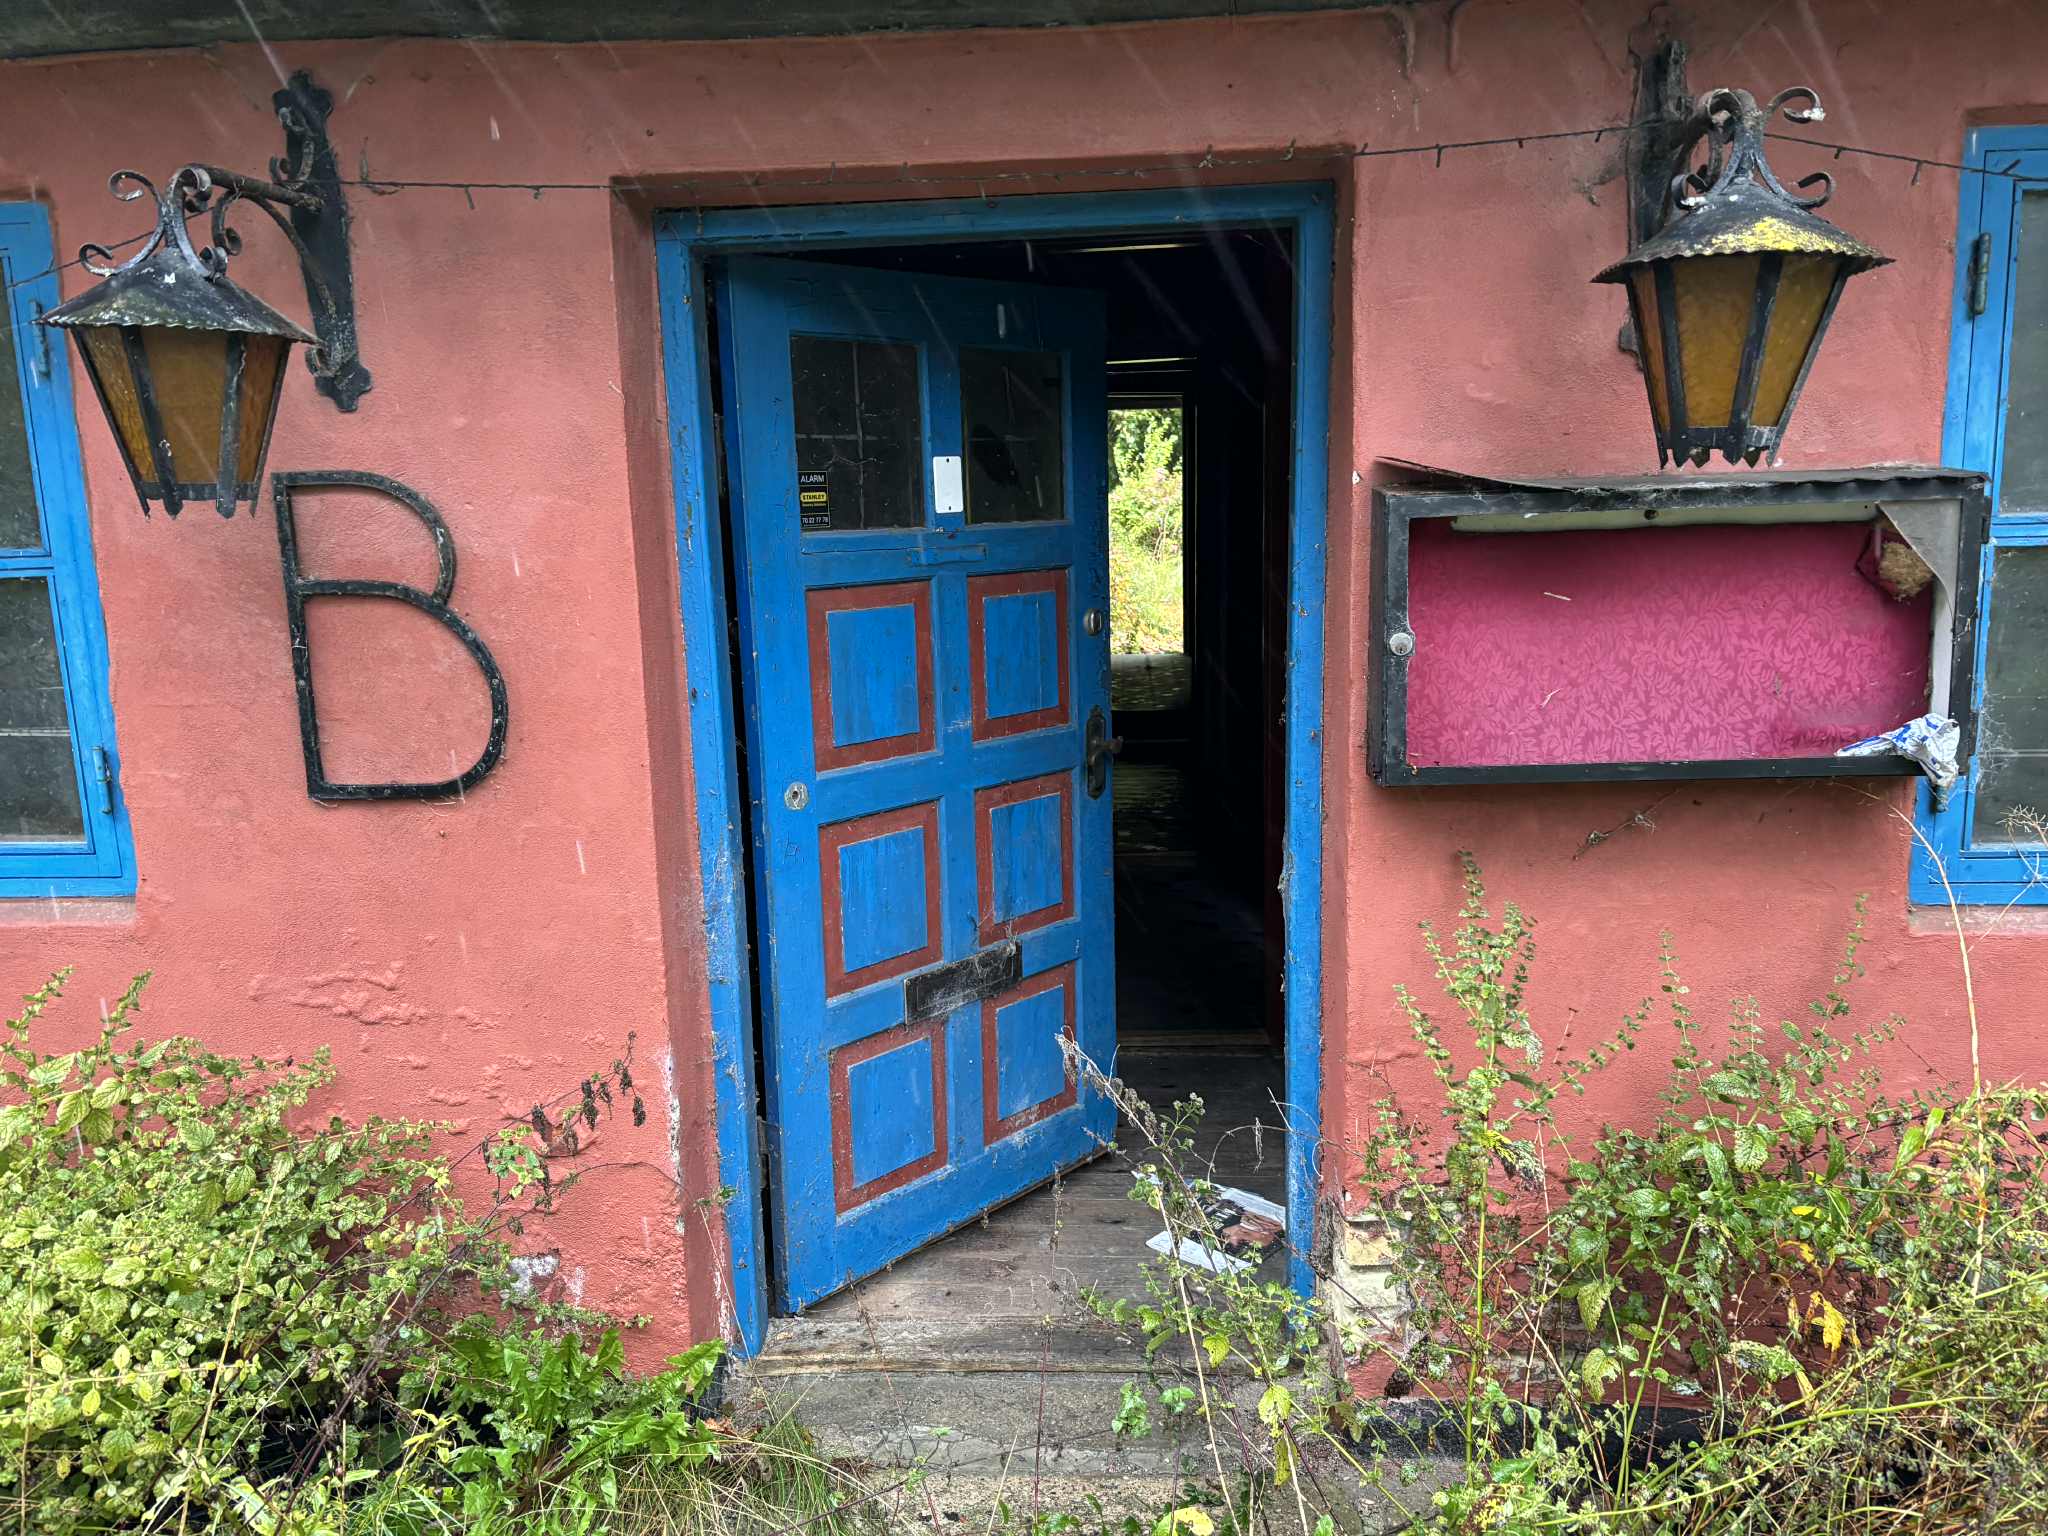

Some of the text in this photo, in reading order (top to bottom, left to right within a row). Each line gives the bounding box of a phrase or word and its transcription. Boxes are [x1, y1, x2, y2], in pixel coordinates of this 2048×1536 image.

[800, 474, 825, 483] ALARM
[802, 493, 826, 501] STANLEY
[271, 470, 509, 802] B
